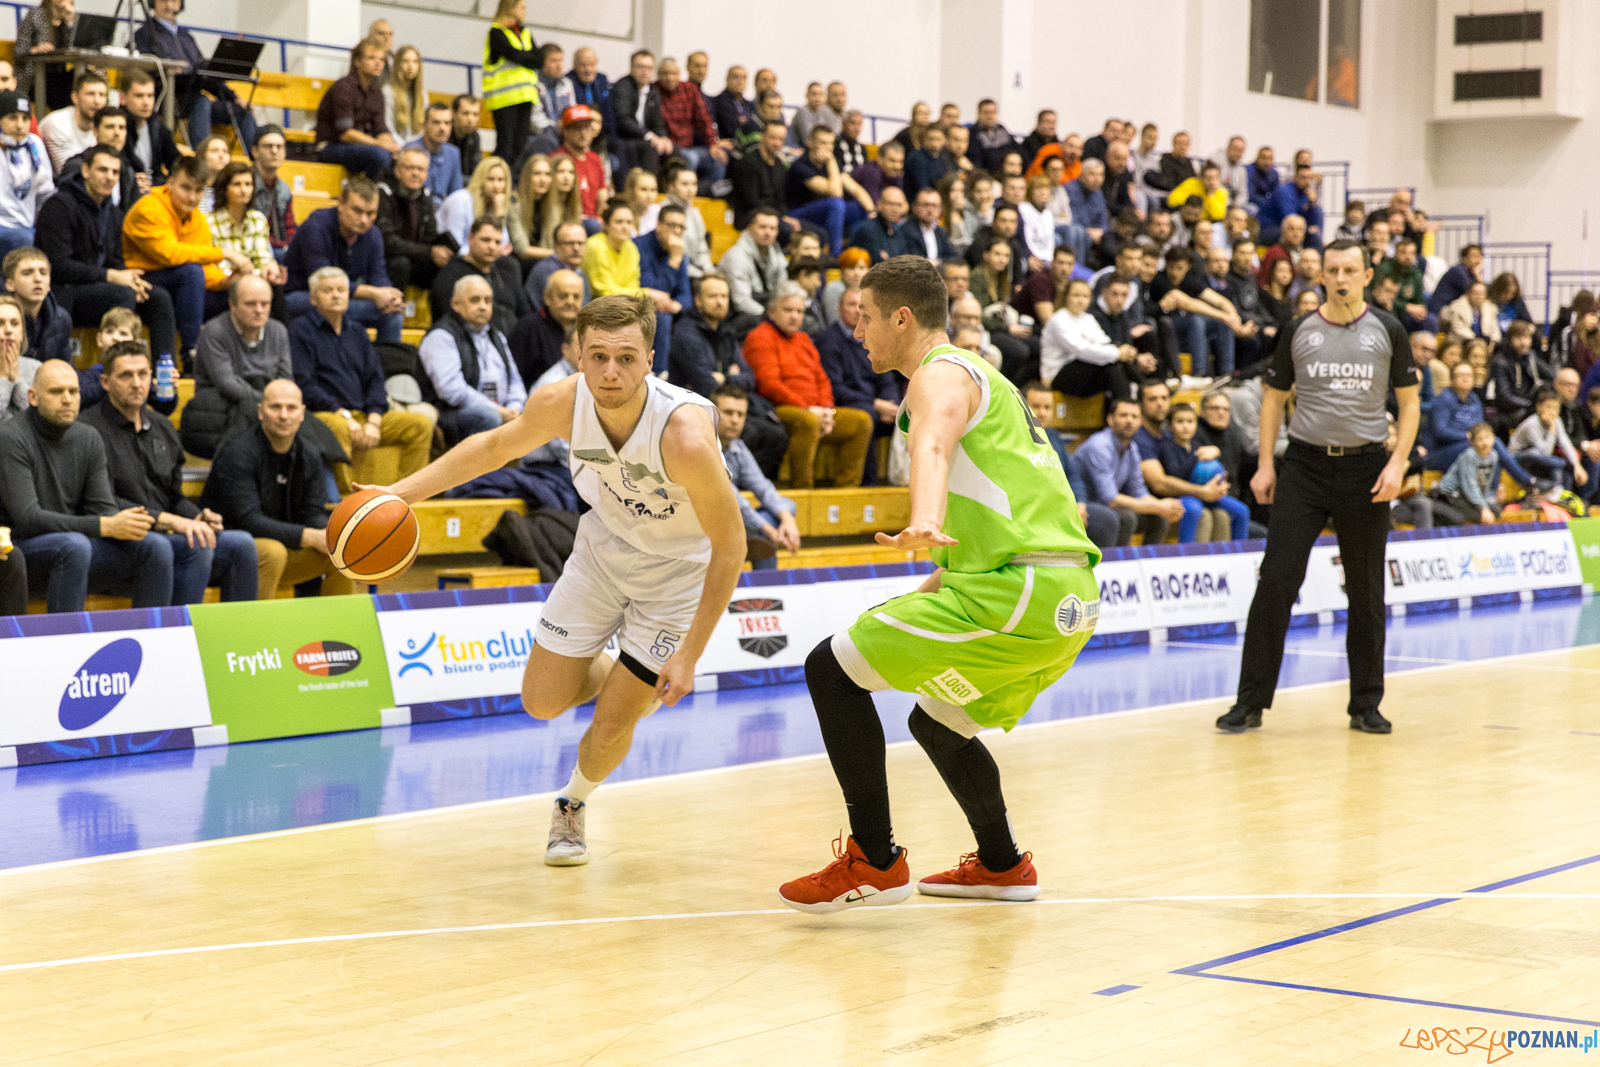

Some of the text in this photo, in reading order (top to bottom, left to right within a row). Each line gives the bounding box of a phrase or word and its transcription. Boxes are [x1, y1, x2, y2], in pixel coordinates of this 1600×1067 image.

[1307, 361, 1374, 379] VERONI
[1404, 556, 1453, 583] NICKEL
[1151, 572, 1231, 600] BIOFARM
[540, 617, 569, 638] macron
[738, 615, 782, 635] JOKER
[296, 649, 359, 665] FARM FRITES
[649, 629, 681, 663] 5
[226, 647, 283, 677] Frytki
[443, 663, 484, 675] biuro
[67, 668, 132, 699] atrem
[940, 673, 972, 699] LOGO
